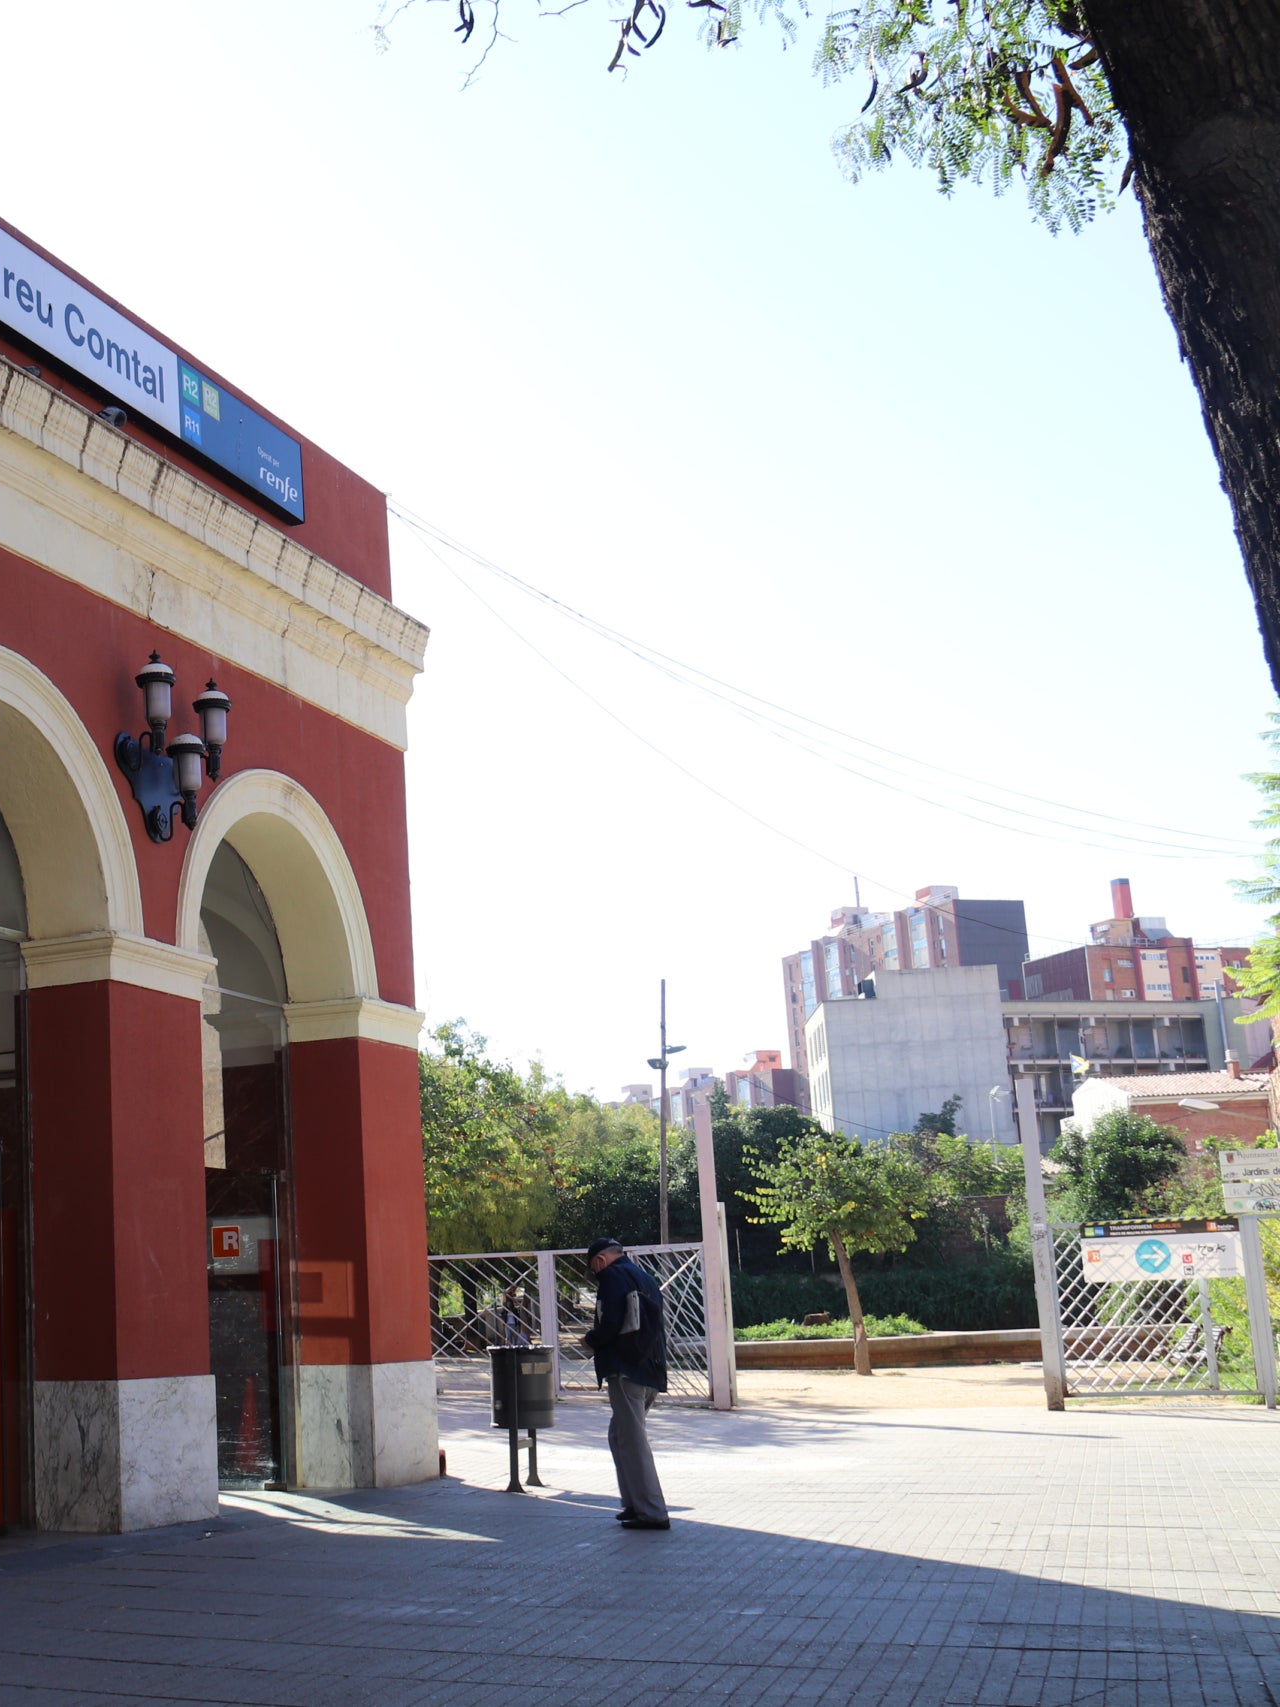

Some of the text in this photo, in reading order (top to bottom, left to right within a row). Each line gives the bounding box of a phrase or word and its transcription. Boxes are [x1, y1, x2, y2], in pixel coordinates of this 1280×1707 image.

[64, 302, 166, 404] Comtal
[182, 374, 200, 400] R2
[184, 414, 200, 435] R11
[259, 467, 298, 502] renfe
[1242, 1167, 1270, 1177] Jardins
[222, 1230, 239, 1251] R
